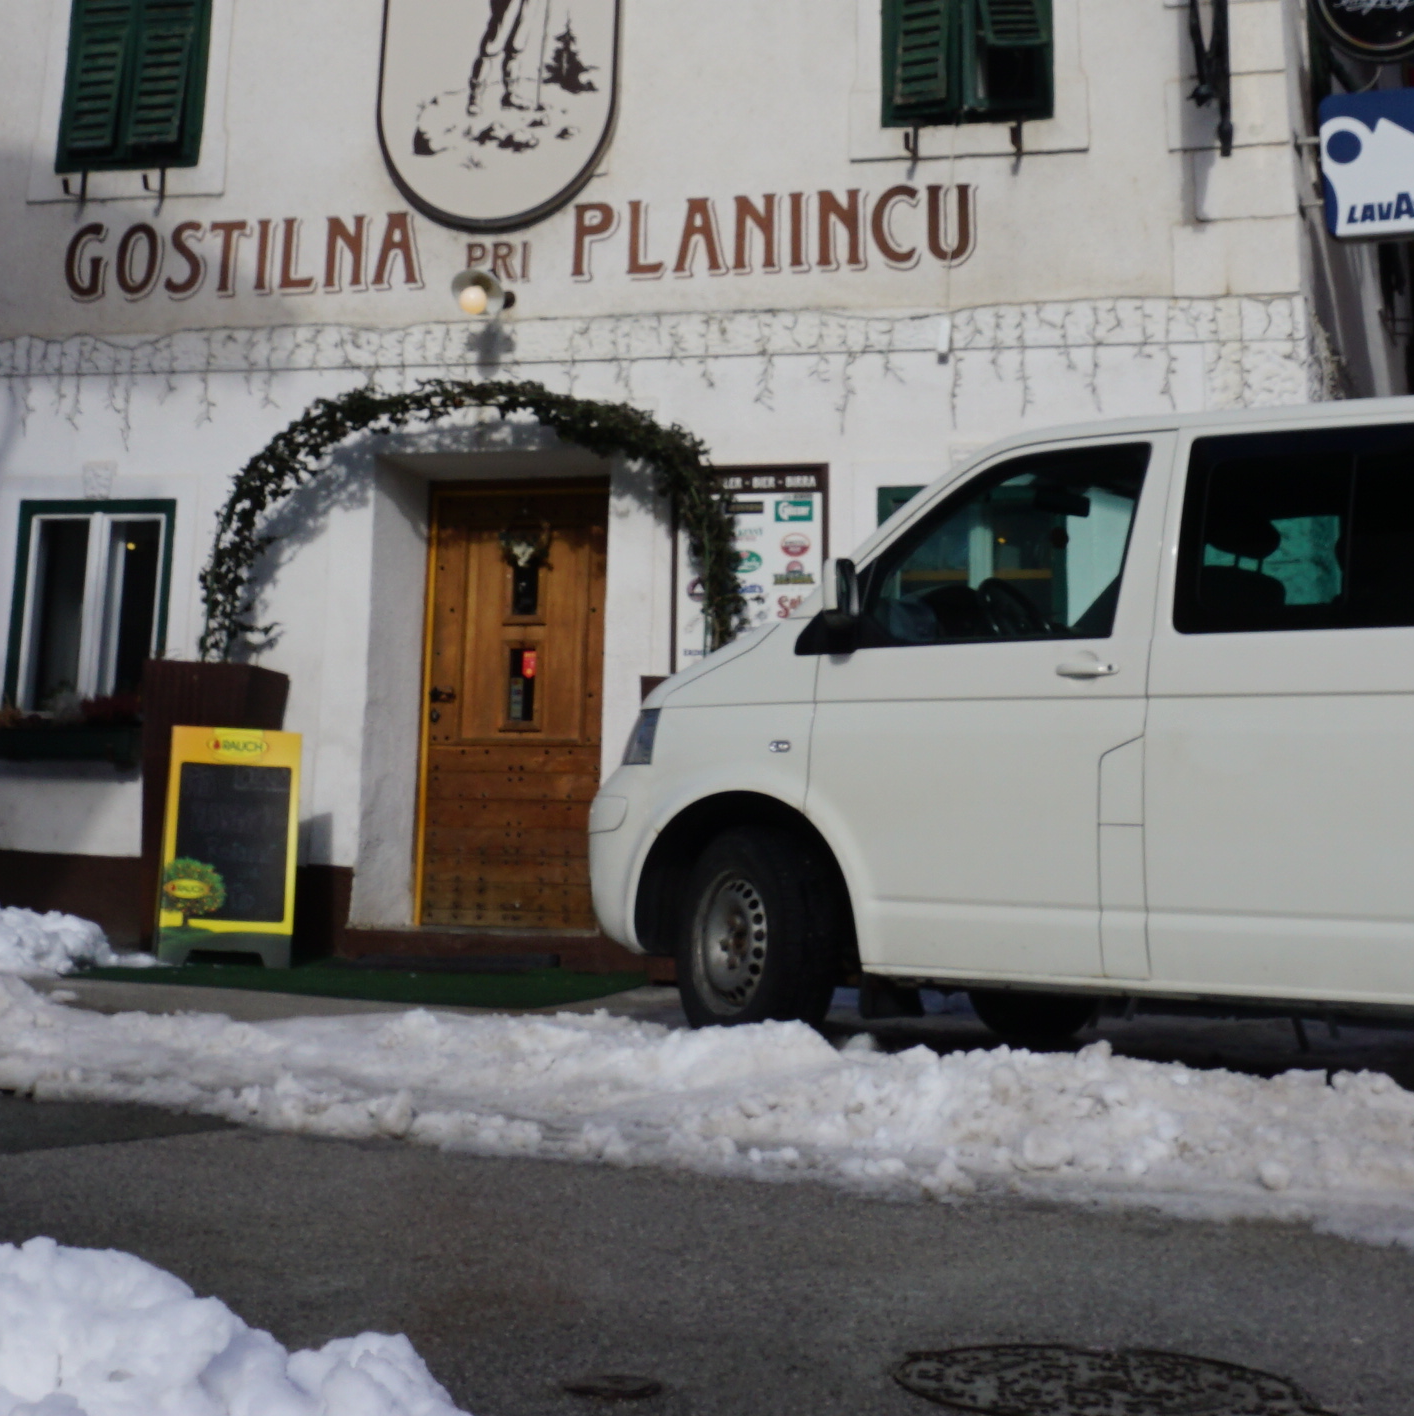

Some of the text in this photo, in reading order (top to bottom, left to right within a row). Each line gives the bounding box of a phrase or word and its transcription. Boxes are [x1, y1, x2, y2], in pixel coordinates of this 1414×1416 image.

[64, 183, 978, 304] GOSTILNA PRI PLANINCU
[221, 738, 264, 752] RAUCH
